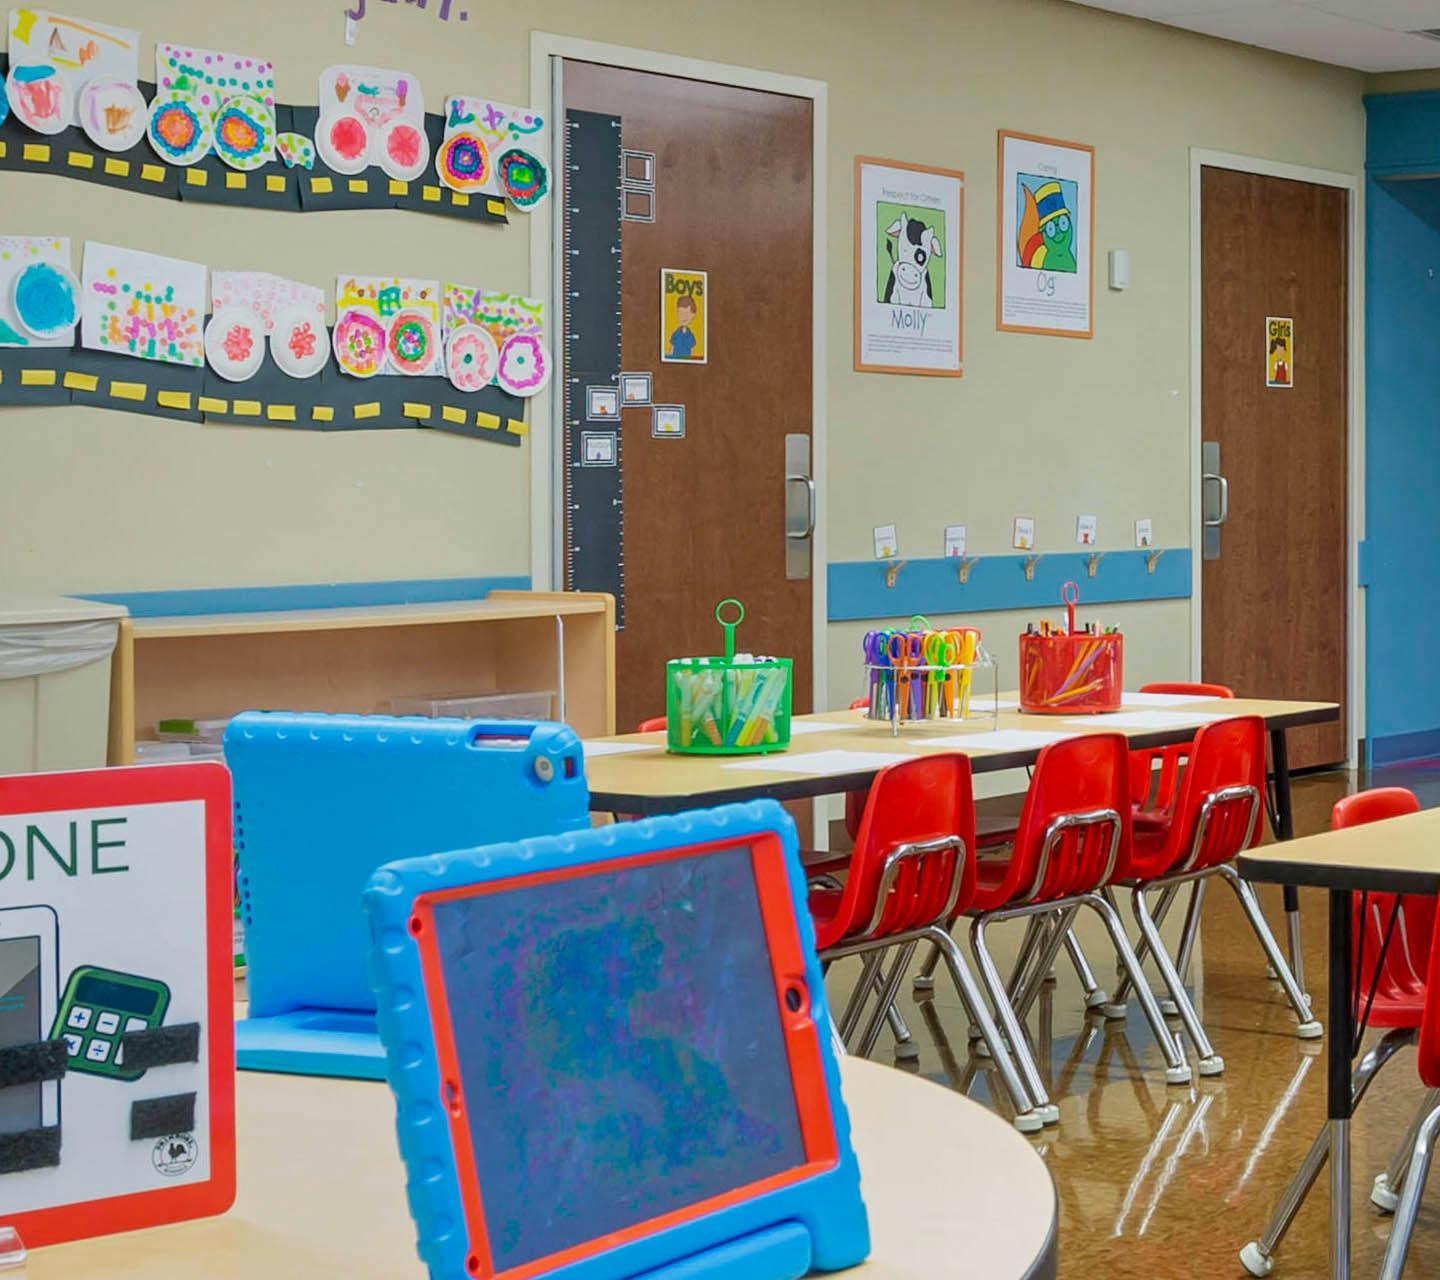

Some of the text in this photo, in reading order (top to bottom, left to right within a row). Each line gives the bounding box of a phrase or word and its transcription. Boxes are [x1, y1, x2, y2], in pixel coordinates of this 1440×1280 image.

[665, 273, 704, 297] Boys
[891, 309, 929, 336] Molly
[1269, 320, 1291, 337] Girls
